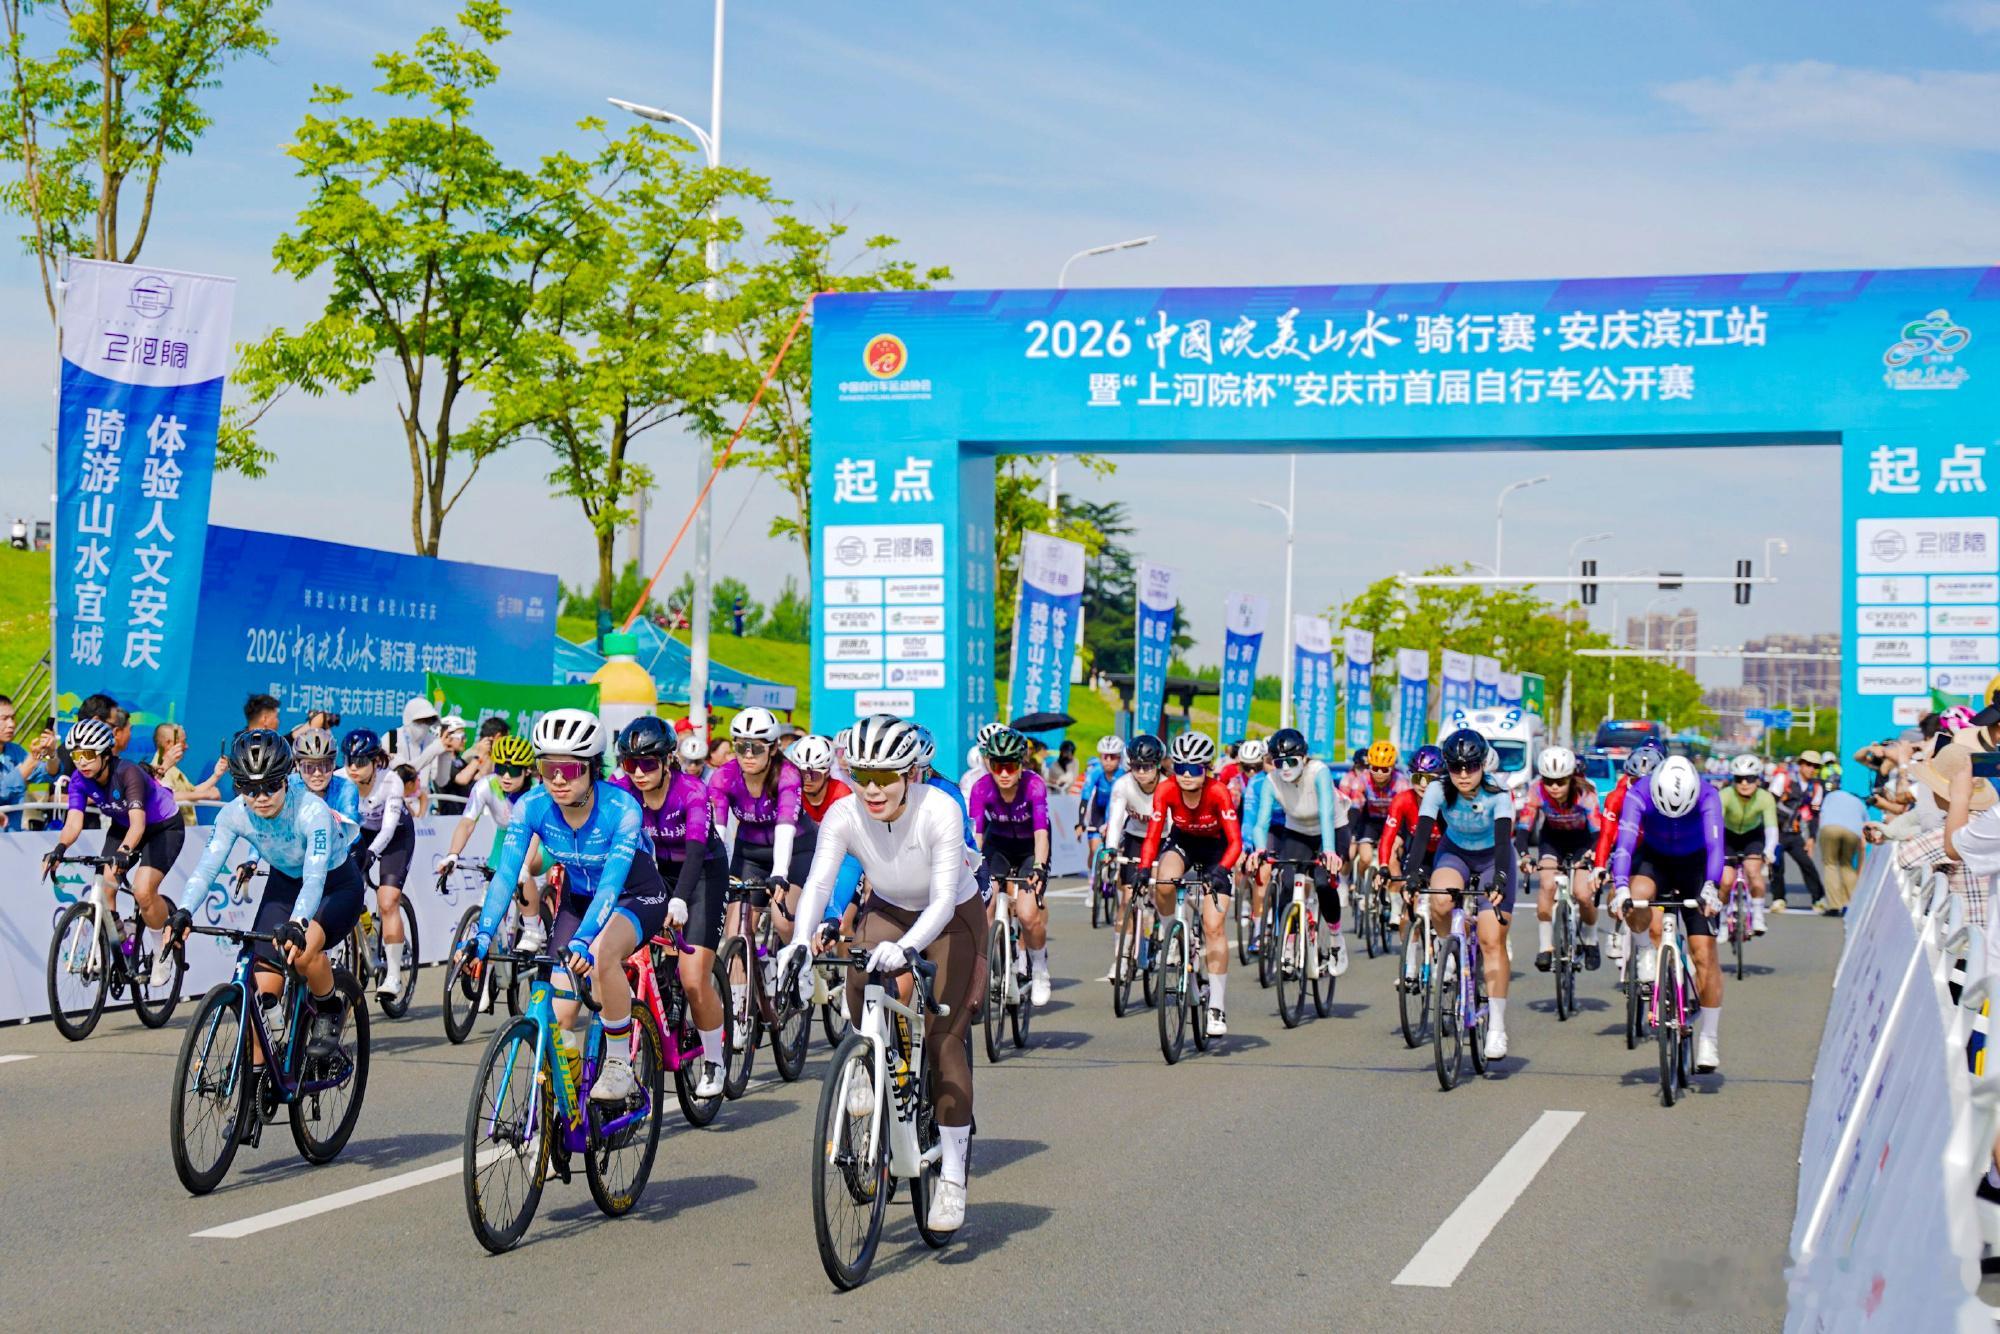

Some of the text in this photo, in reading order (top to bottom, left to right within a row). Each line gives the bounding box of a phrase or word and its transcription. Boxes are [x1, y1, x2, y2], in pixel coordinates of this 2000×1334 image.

[833, 456, 935, 504] 起点
[1867, 443, 1988, 495] 起点
[71, 407, 126, 667] 骑游山水宜城
[122, 414, 187, 670] 体验人文安庆
[314, 828, 326, 856] TECH
